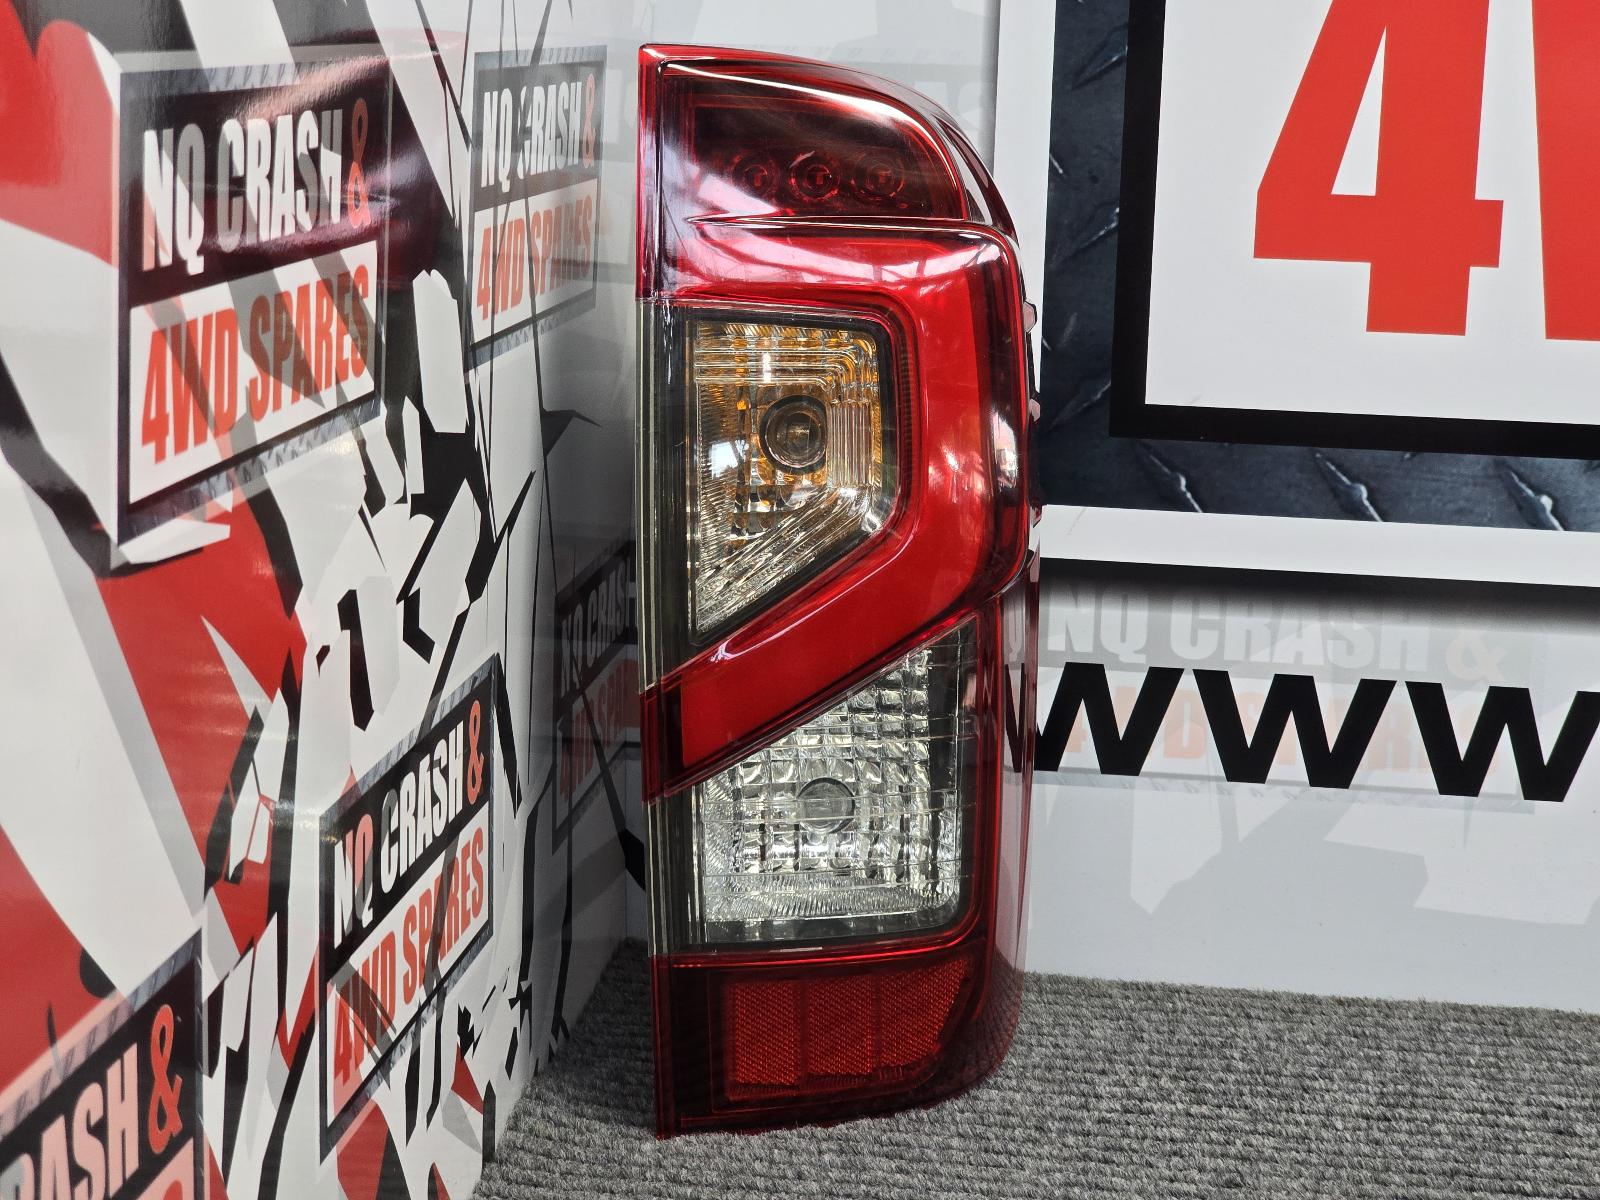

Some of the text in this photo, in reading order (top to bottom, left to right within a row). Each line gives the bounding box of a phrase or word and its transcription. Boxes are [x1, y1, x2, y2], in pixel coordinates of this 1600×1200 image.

[142, 98, 372, 275] NQ CRASH &
[480, 72, 597, 193] NQ CRASH &
[476, 195, 593, 321] 4WD SPARES
[141, 264, 371, 466] 4WD SPARES
[1047, 583, 1149, 664] NQ
[1170, 584, 1429, 673] CRASH
[333, 699, 485, 950] NQ CRASH &
[333, 826, 484, 1087] 4WD SPARES
[148, 1004, 183, 1155] &
